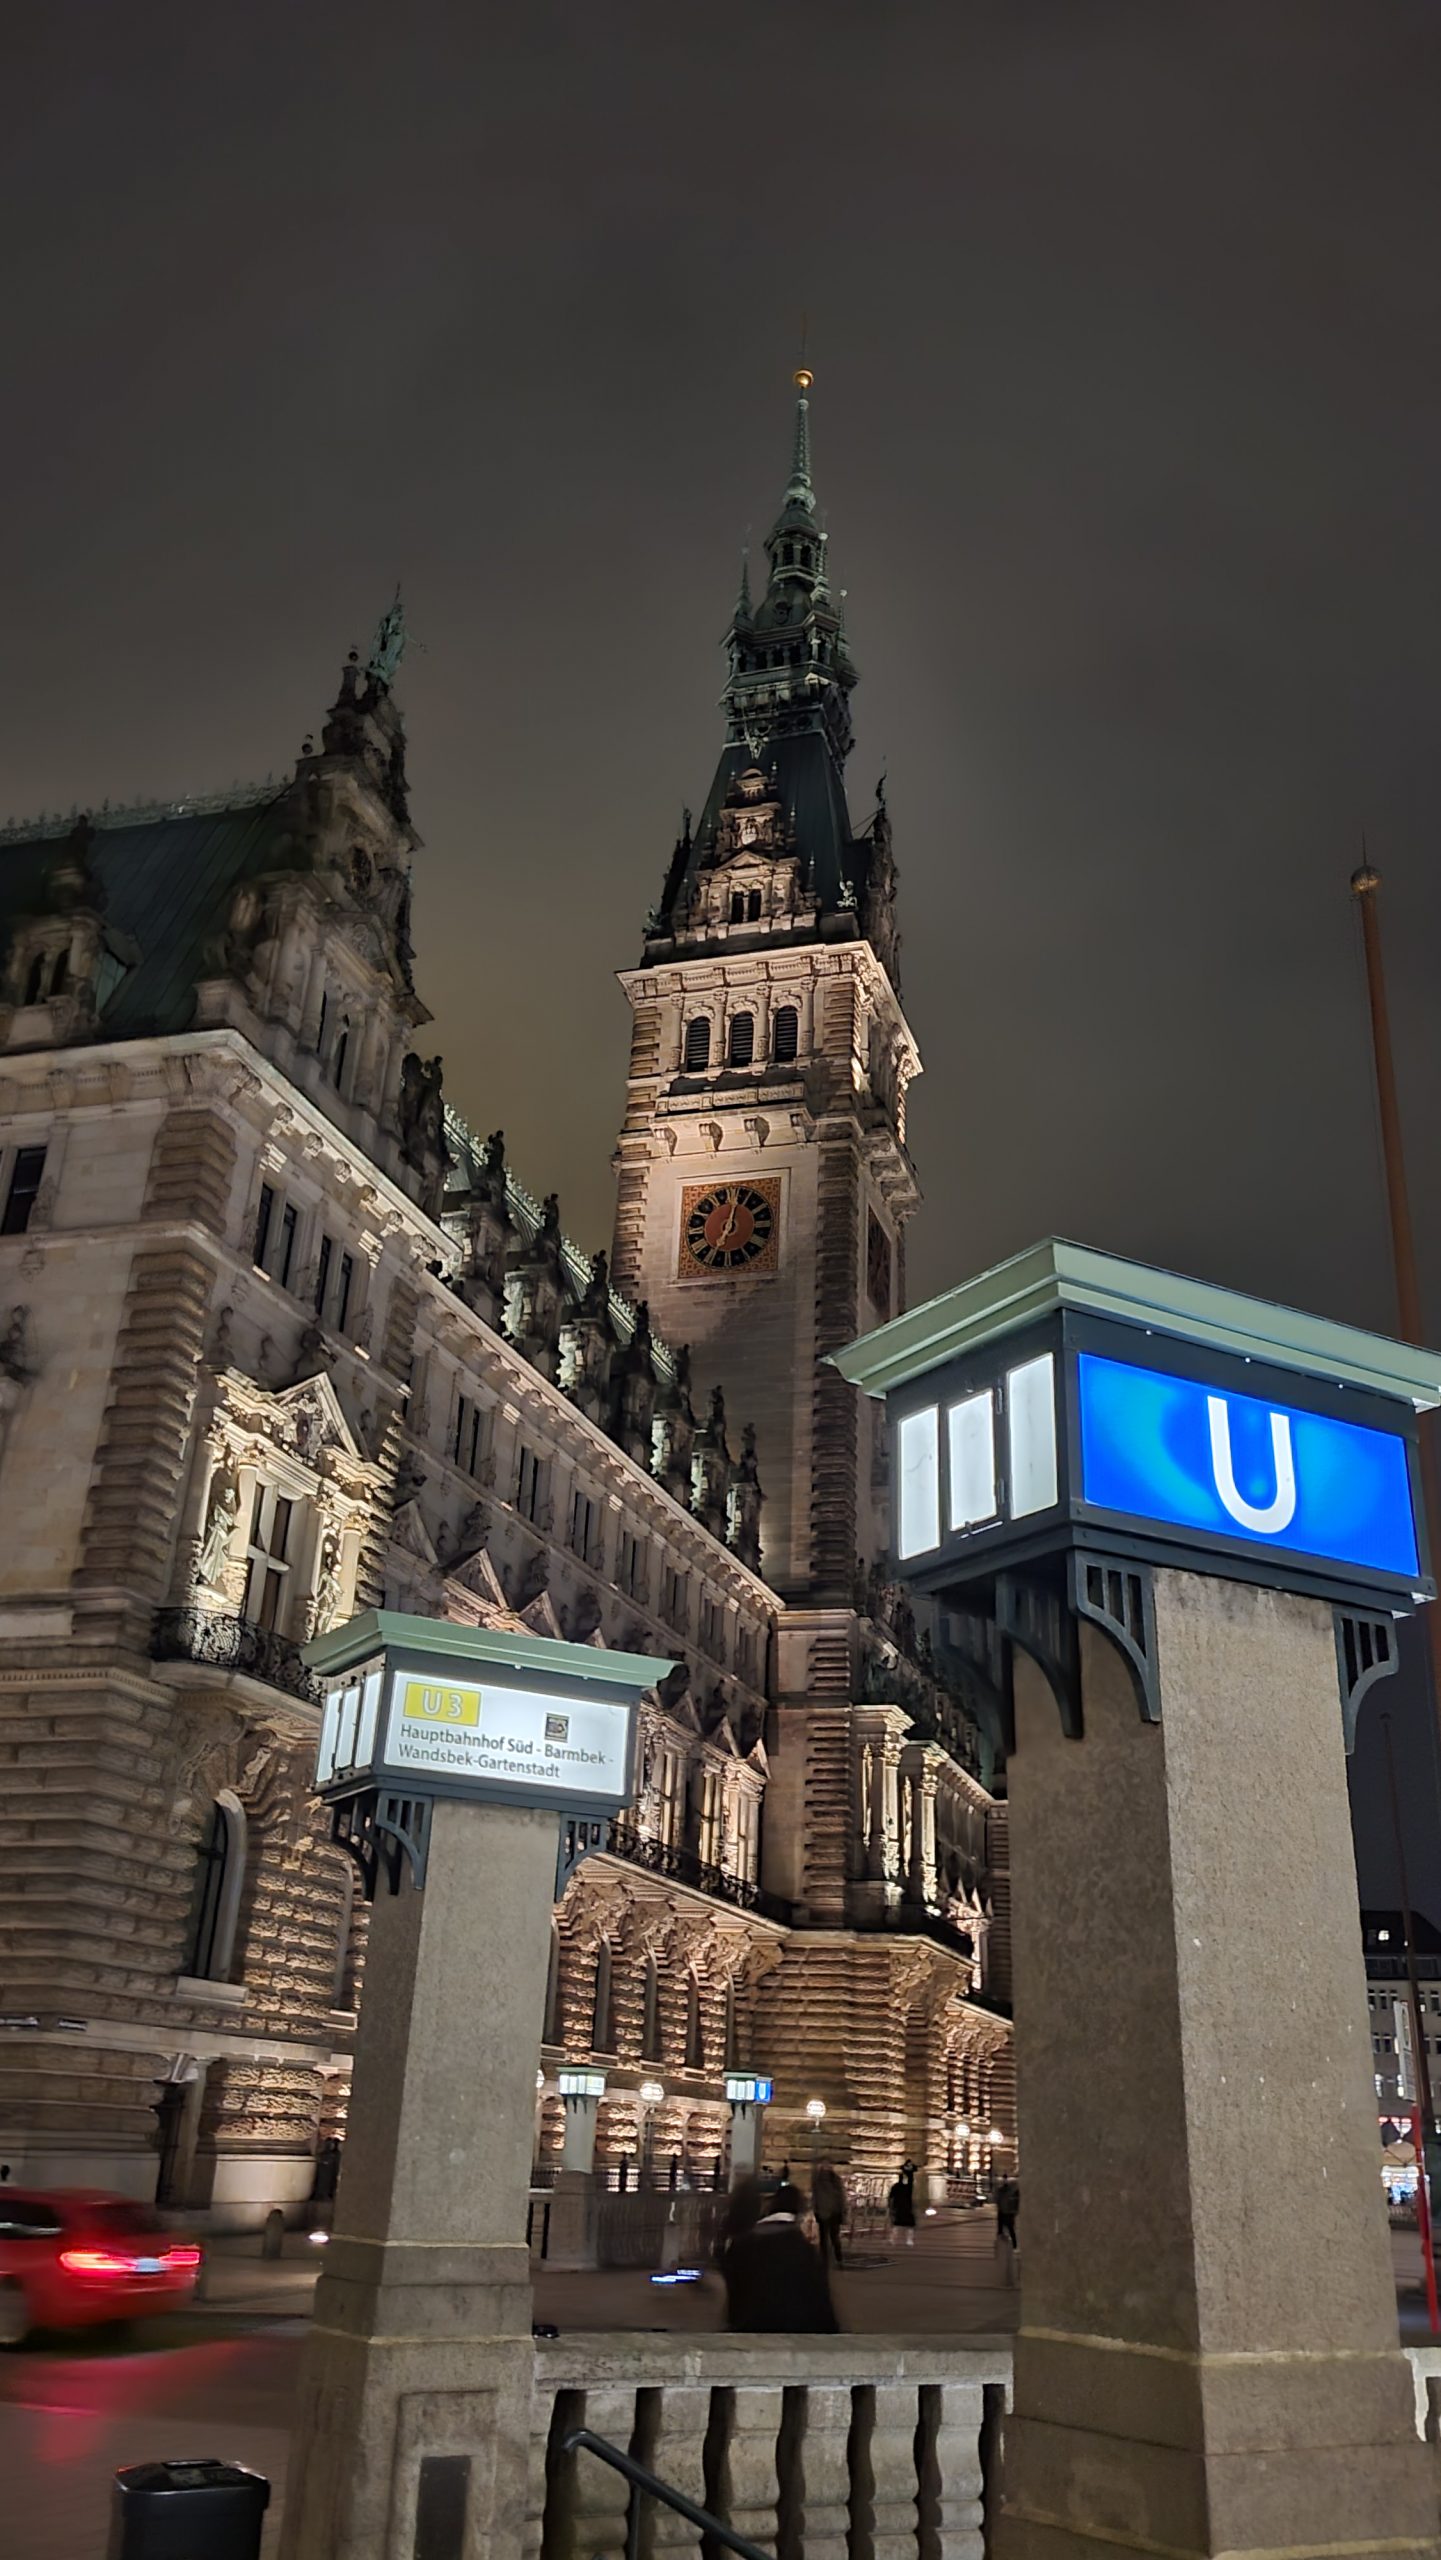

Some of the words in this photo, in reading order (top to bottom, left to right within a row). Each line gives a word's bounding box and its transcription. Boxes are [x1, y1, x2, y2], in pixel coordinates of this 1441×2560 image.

[1207, 1395, 1296, 1533] U
[398, 1743, 560, 1778] Wandsbek-Gartenstadt
[400, 1724, 505, 1751] Hauptbahnhof
[507, 1738, 533, 1754] Süd
[544, 1744, 606, 1765] Barmbek
